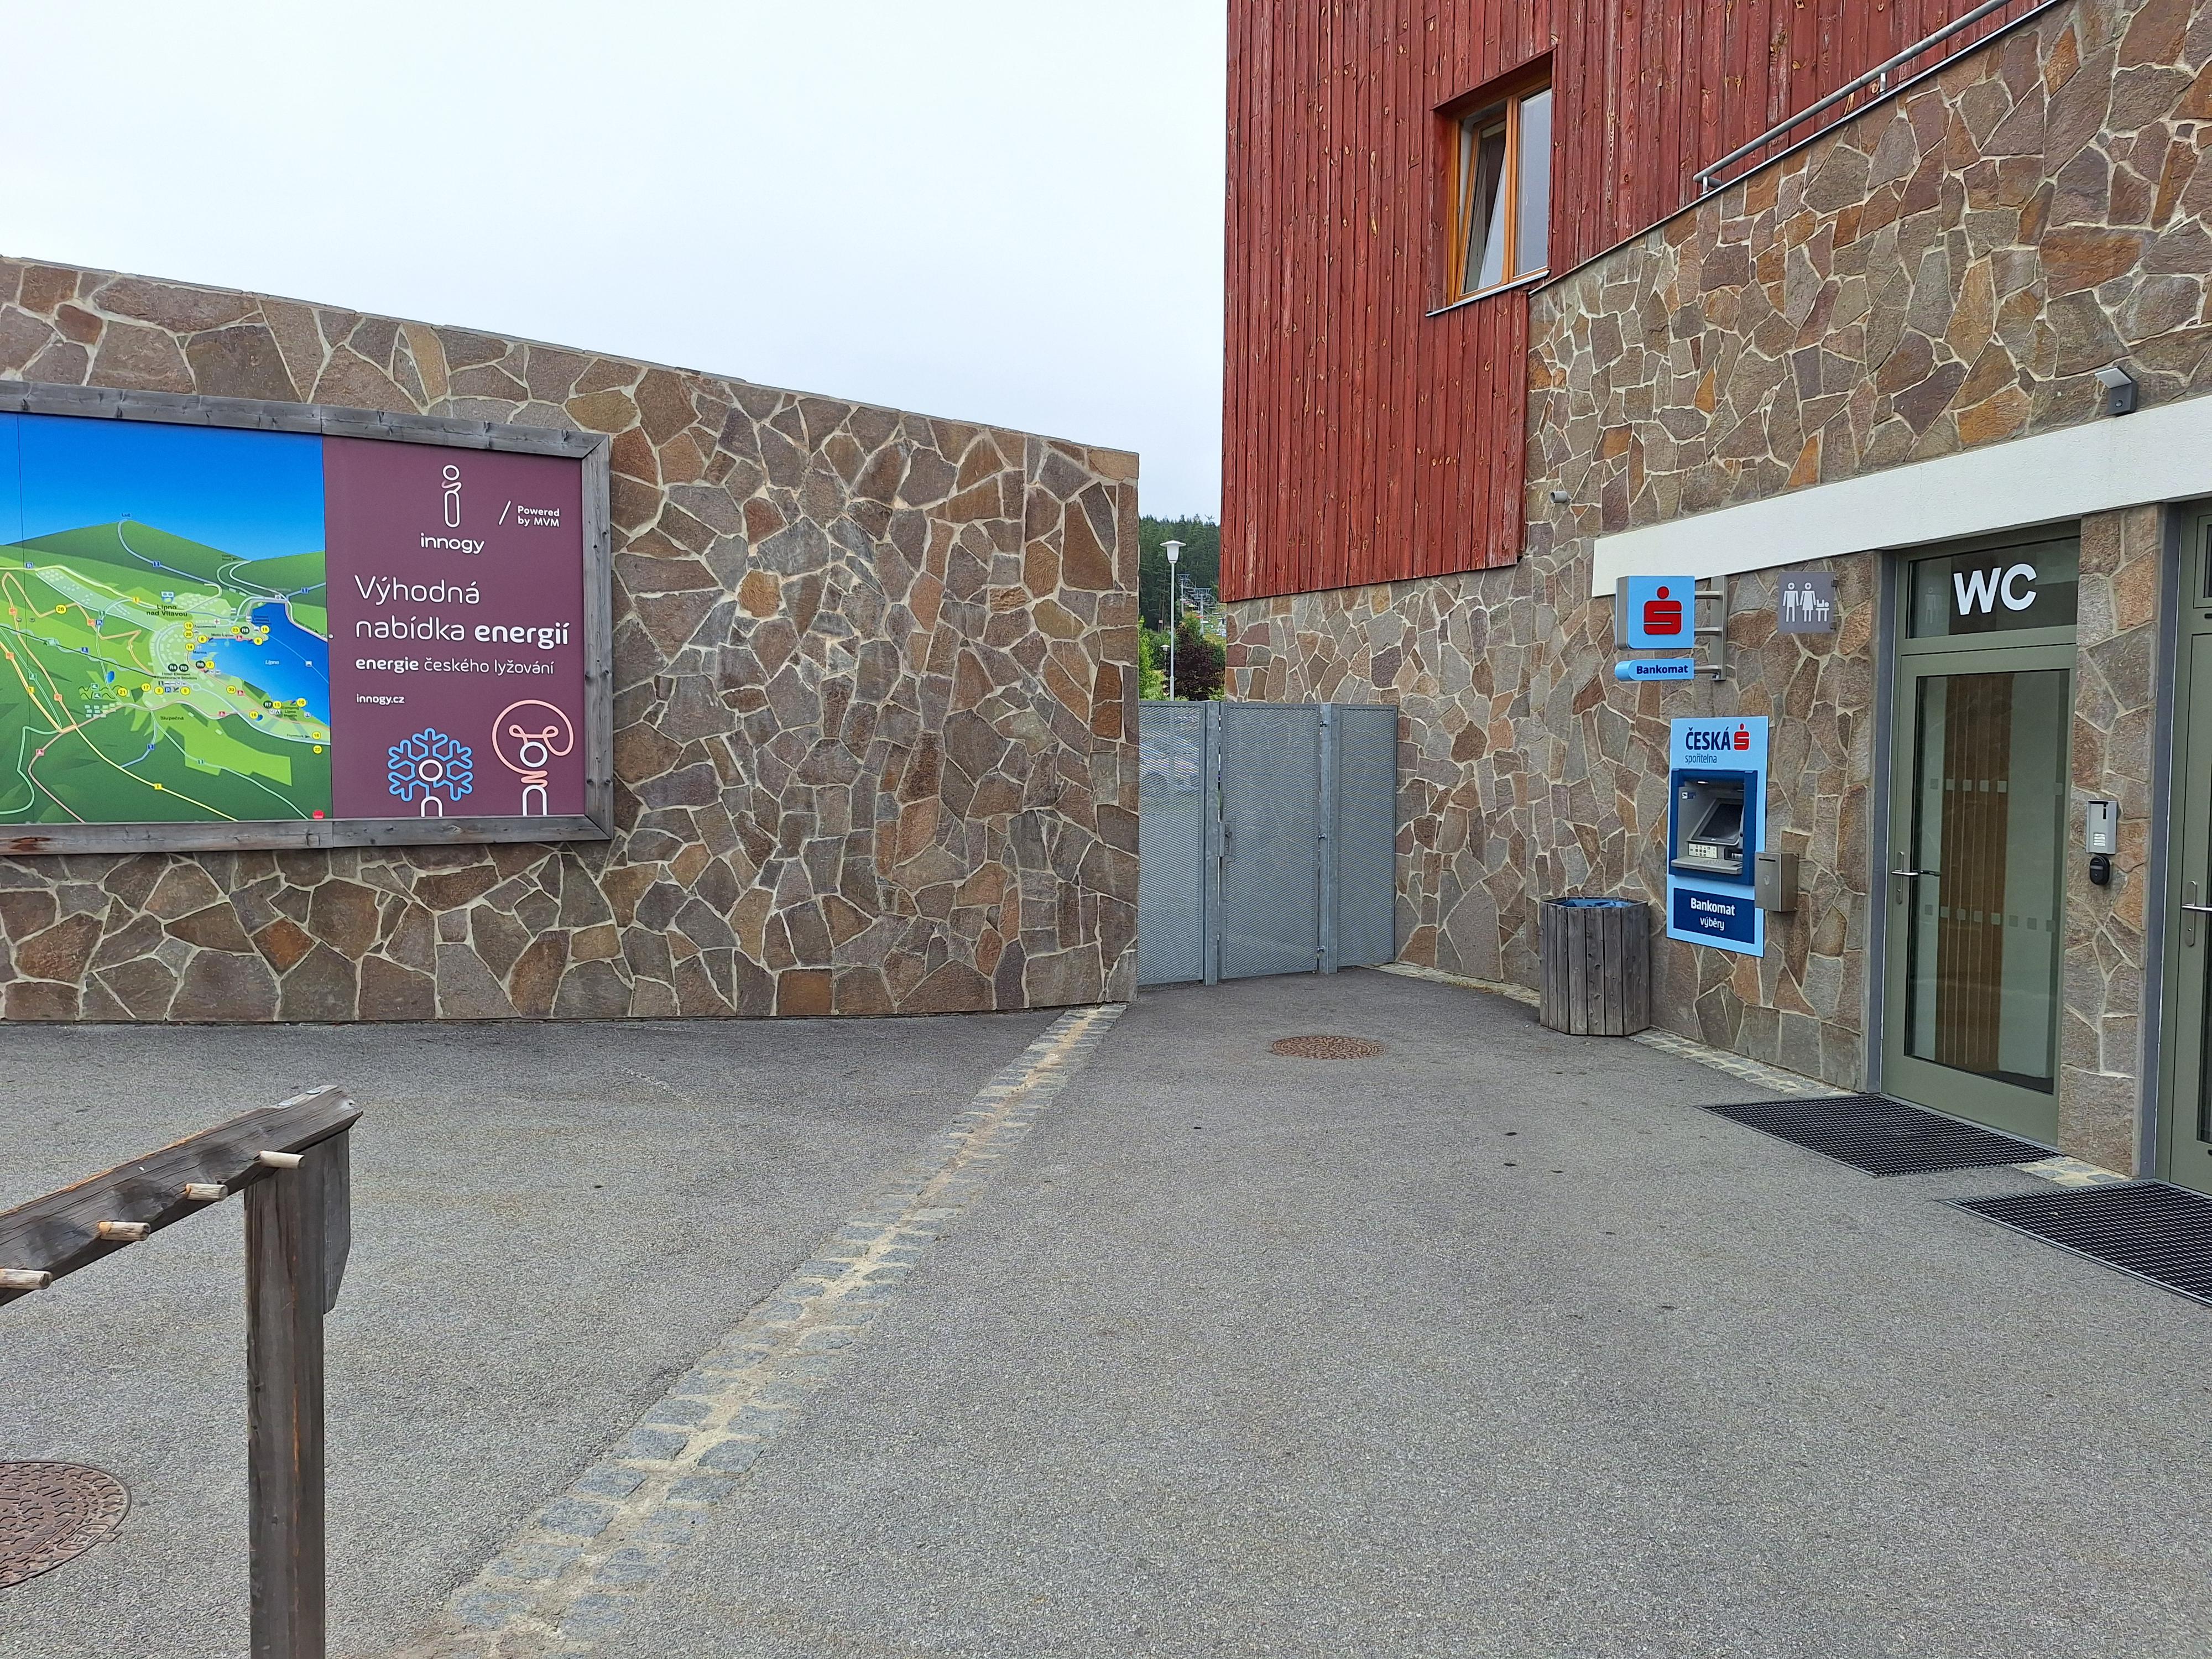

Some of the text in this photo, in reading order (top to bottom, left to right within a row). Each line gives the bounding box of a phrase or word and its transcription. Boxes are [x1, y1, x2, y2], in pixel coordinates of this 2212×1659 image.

[518, 505, 560, 517] Powered
[518, 517, 560, 527] by MVM
[420, 532, 485, 554] innogy
[354, 575, 480, 605] Výhodná
[1953, 563, 2037, 615] WC
[356, 615, 570, 650] nabídka energií
[356, 657, 554, 677] energie českého lyžování
[1636, 664, 1688, 675] Bankomat
[356, 694, 405, 705] innogy.cz
[1685, 727, 1731, 750] ČESKÁ
[1684, 753, 1717, 764] spořitelna
[1690, 897, 1735, 916] Bankomat
[1699, 916, 1725, 932] výběry
